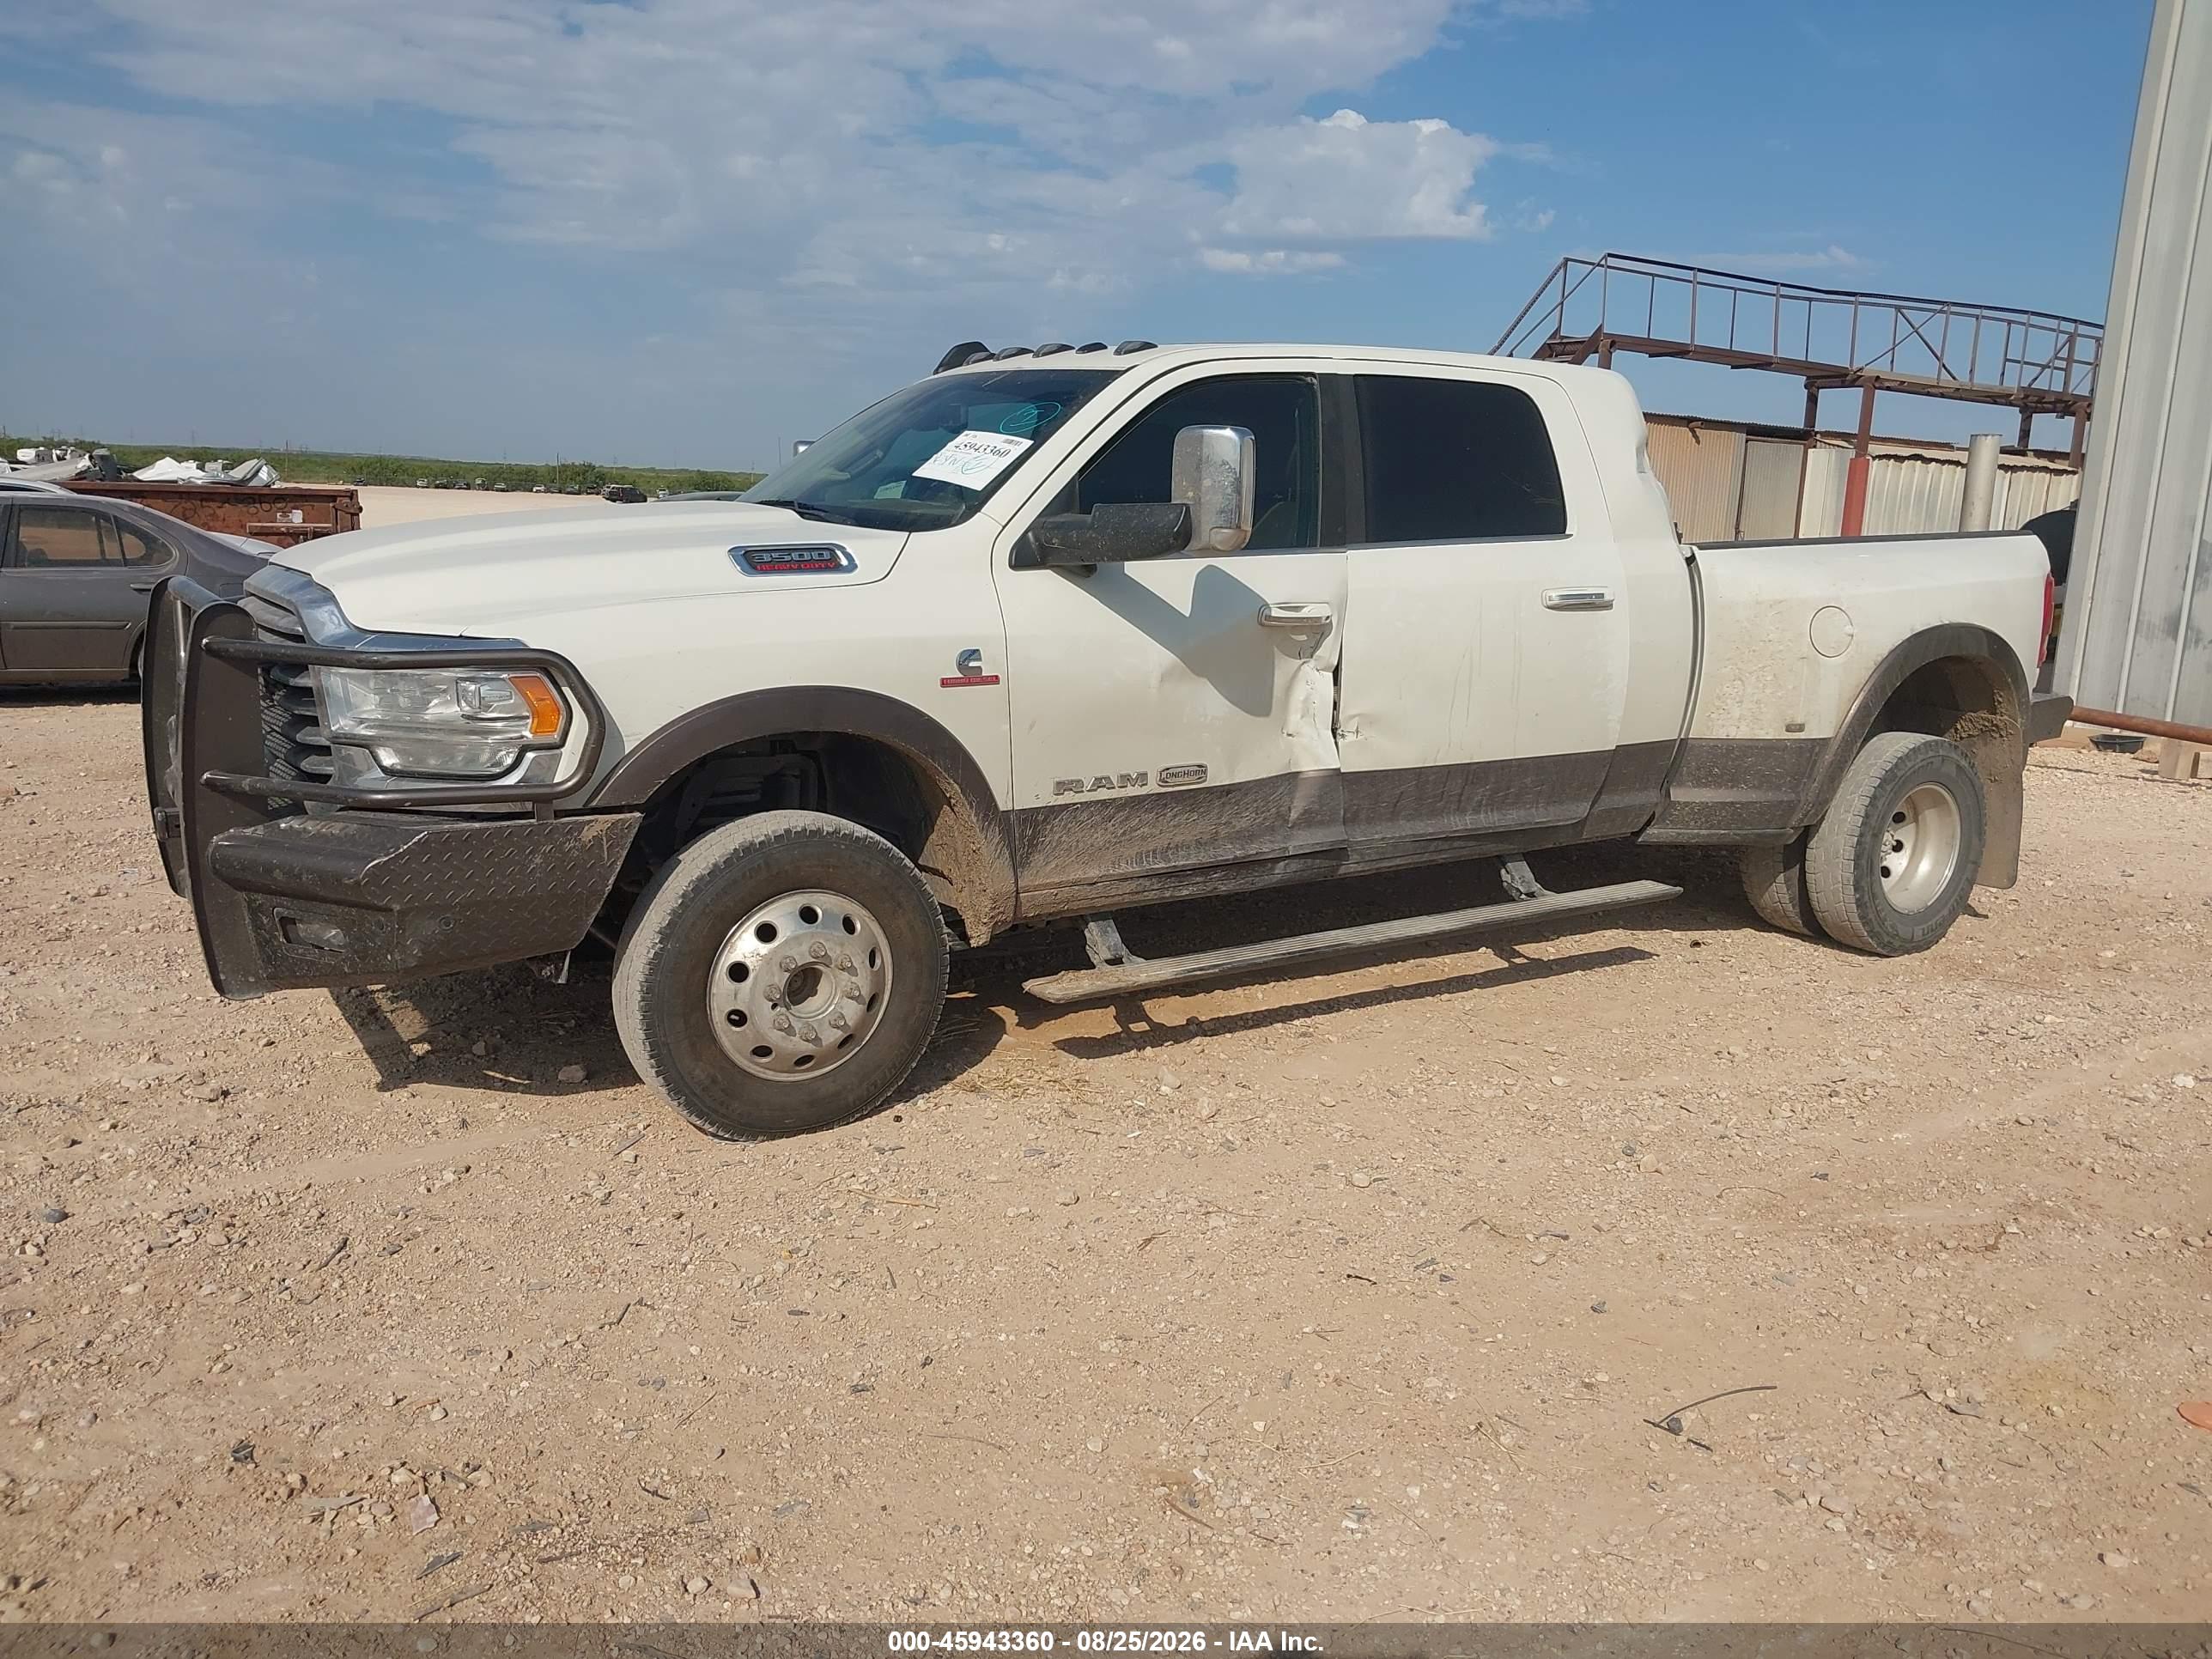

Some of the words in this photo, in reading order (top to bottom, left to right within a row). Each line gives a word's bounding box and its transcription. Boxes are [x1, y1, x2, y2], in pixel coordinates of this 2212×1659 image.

[954, 441, 1012, 459] 45943360
[751, 550, 832, 562] 3500
[1159, 768, 1208, 781] LONGHORN
[1053, 771, 1149, 795] RAM
